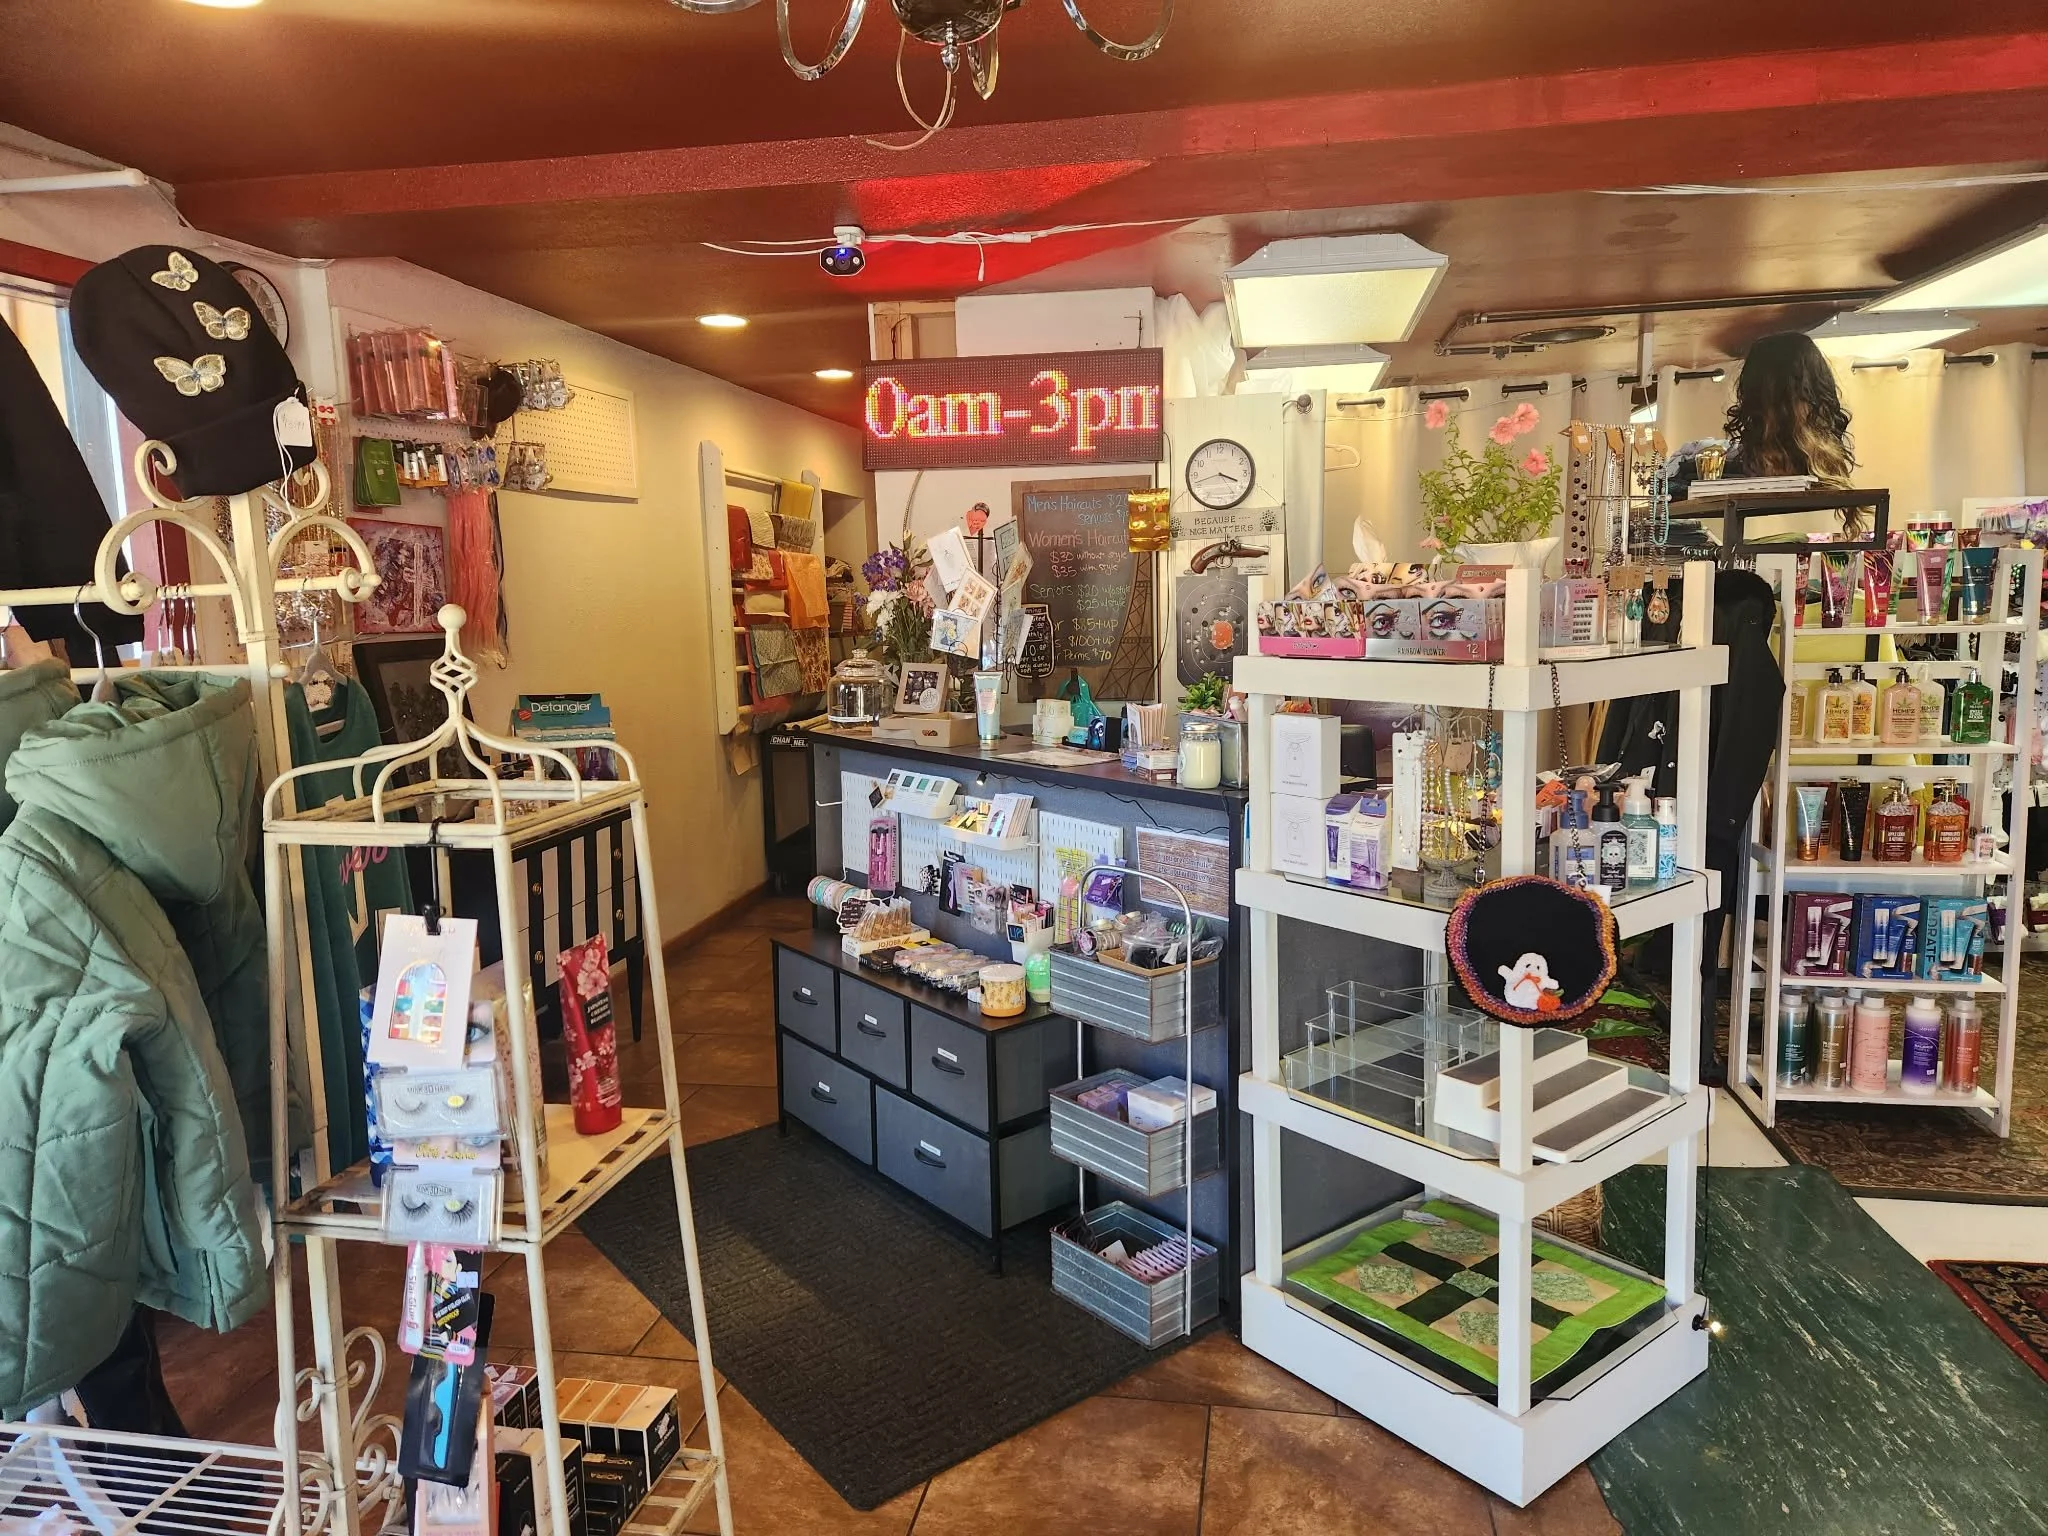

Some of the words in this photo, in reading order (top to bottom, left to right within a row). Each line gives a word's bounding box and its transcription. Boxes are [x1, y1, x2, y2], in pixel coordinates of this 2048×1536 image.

[1027, 495, 1057, 512] Men's
[1060, 495, 1101, 512] Haircuts
[1194, 516, 1236, 525] BECAUSE
[1189, 527, 1208, 536] NICE
[1209, 525, 1254, 535] MATTERS
[1028, 529, 1083, 548] Women's
[1049, 550, 1074, 564] $30
[1051, 564, 1078, 578] $35
[1030, 583, 1073, 600] Seniors
[1077, 584, 1099, 599] $20
[1076, 600, 1099, 612] $25
[1064, 650, 1091, 661] Perms
[1092, 648, 1112, 661] $70
[1466, 643, 1479, 655] 12
[531, 702, 591, 713] Detangler
